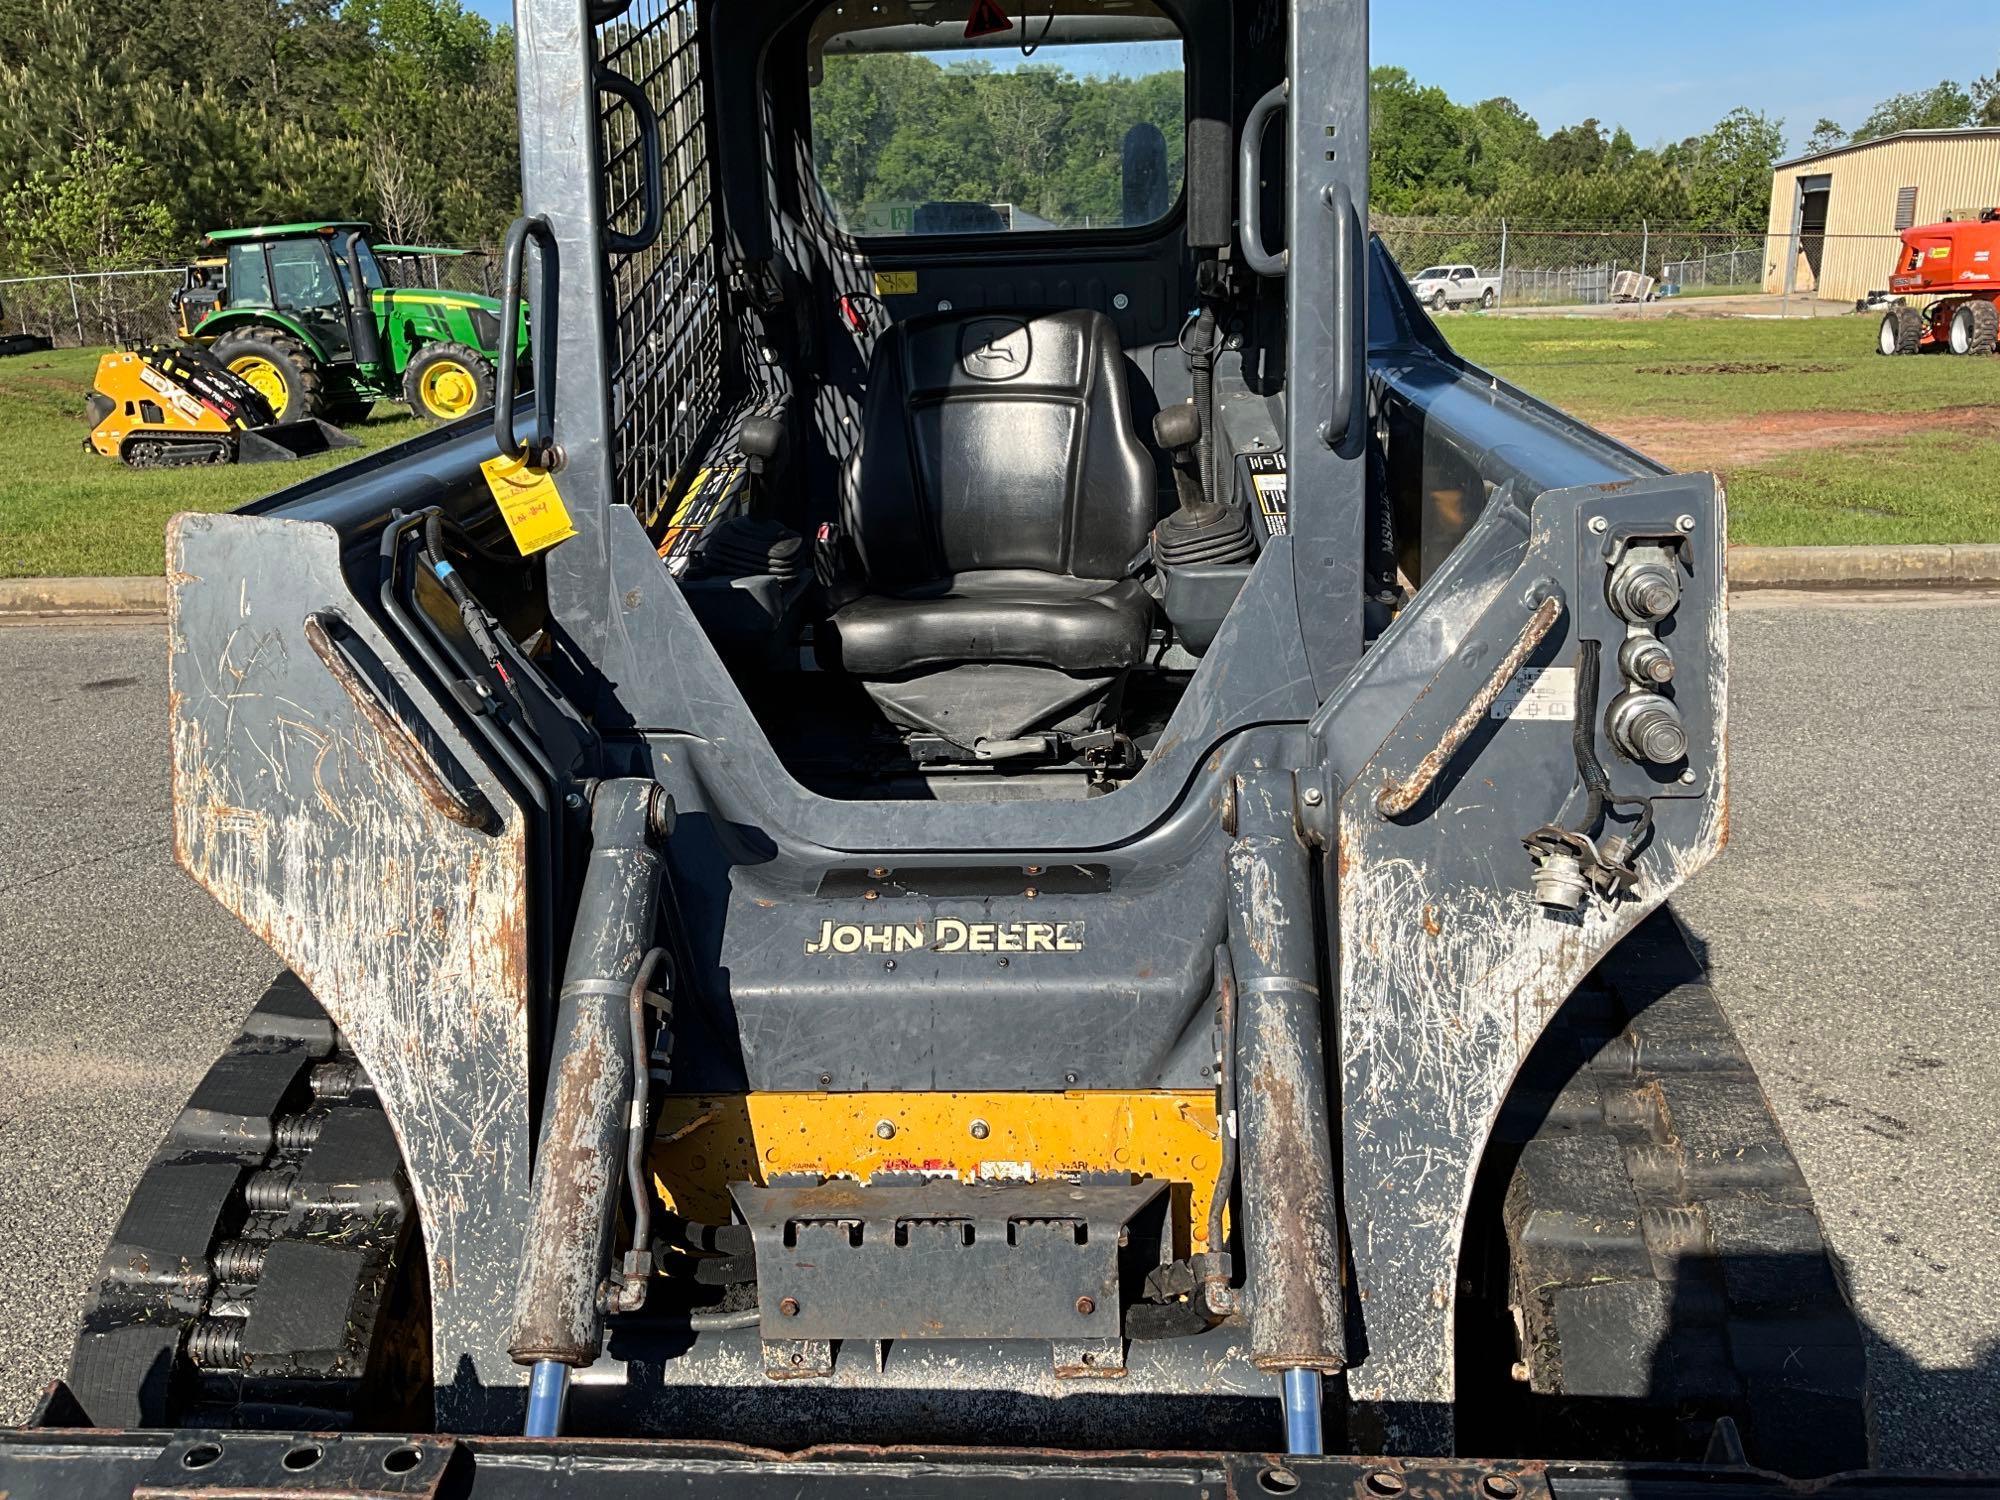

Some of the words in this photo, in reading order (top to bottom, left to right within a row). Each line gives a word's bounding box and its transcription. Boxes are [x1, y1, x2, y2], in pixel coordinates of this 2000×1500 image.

[140, 366, 205, 421] BOXER
[805, 919, 925, 954] JOHN
[935, 917, 1085, 952] DEERE
